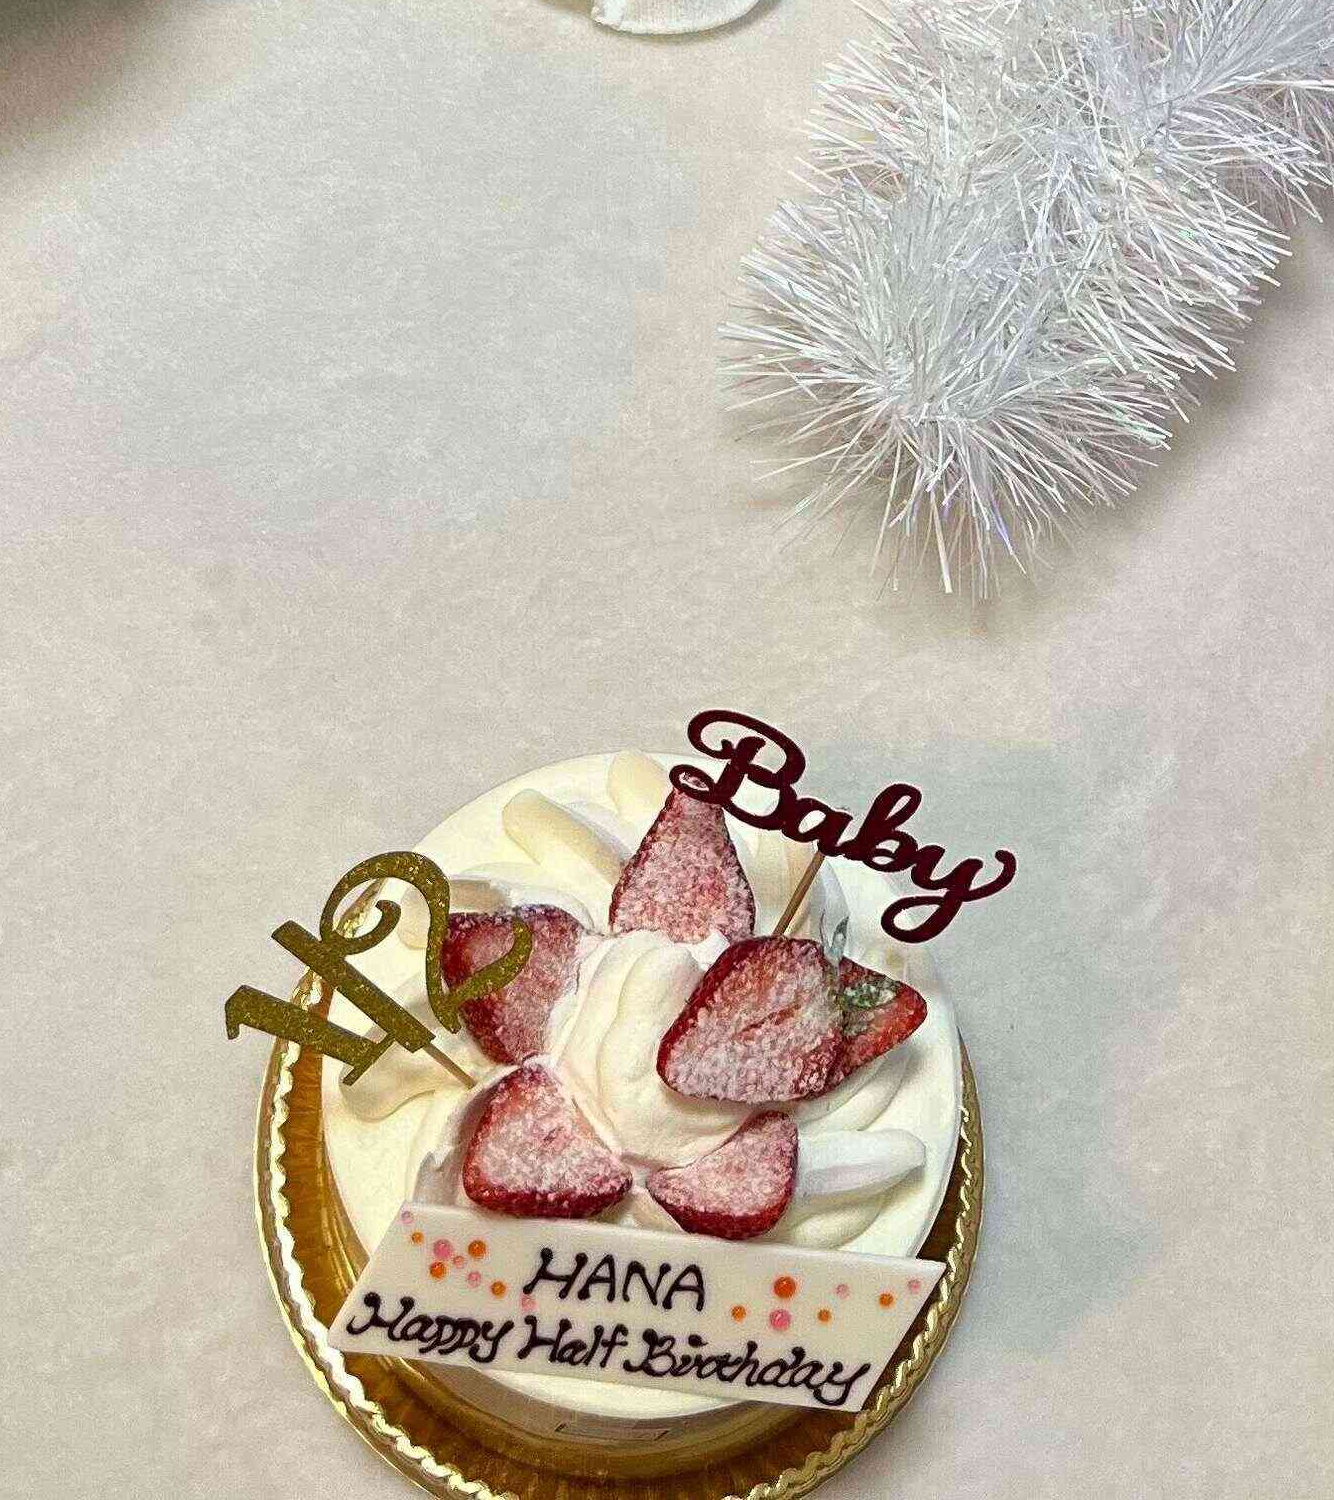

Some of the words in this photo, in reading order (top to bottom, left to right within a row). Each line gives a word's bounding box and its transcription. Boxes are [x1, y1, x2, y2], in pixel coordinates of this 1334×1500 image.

[668, 709, 1017, 943] Baby
[523, 1247, 707, 1312] HANA
[346, 1292, 515, 1364] Happy
[518, 1315, 629, 1368] Half
[623, 1328, 870, 1406] Birthday
